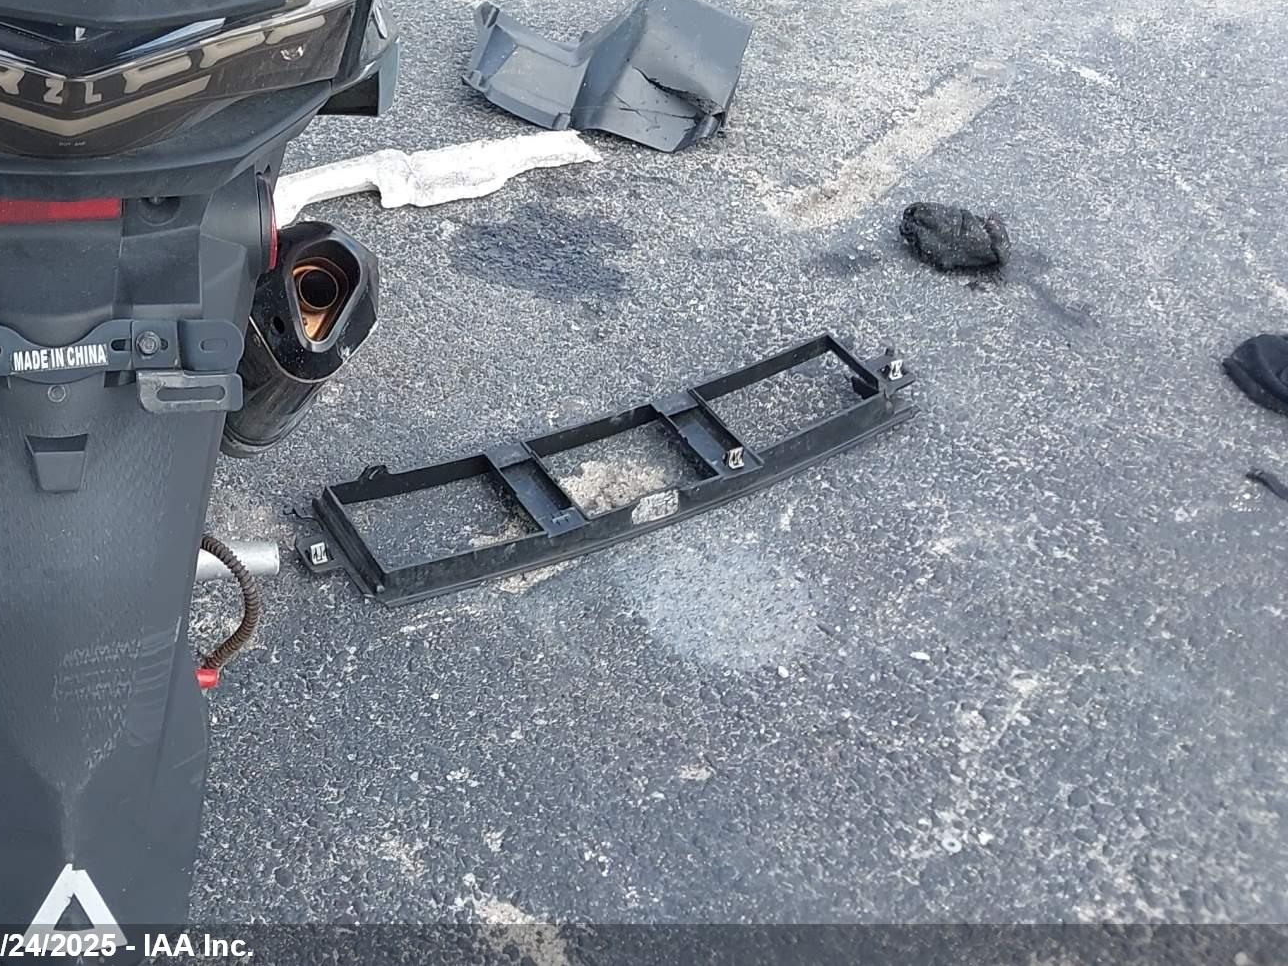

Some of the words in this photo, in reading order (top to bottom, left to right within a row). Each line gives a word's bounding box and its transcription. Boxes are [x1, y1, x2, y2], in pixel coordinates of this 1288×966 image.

[13, 349, 49, 371] MADE
[50, 348, 65, 368] IN
[67, 344, 107, 365] CHINA
